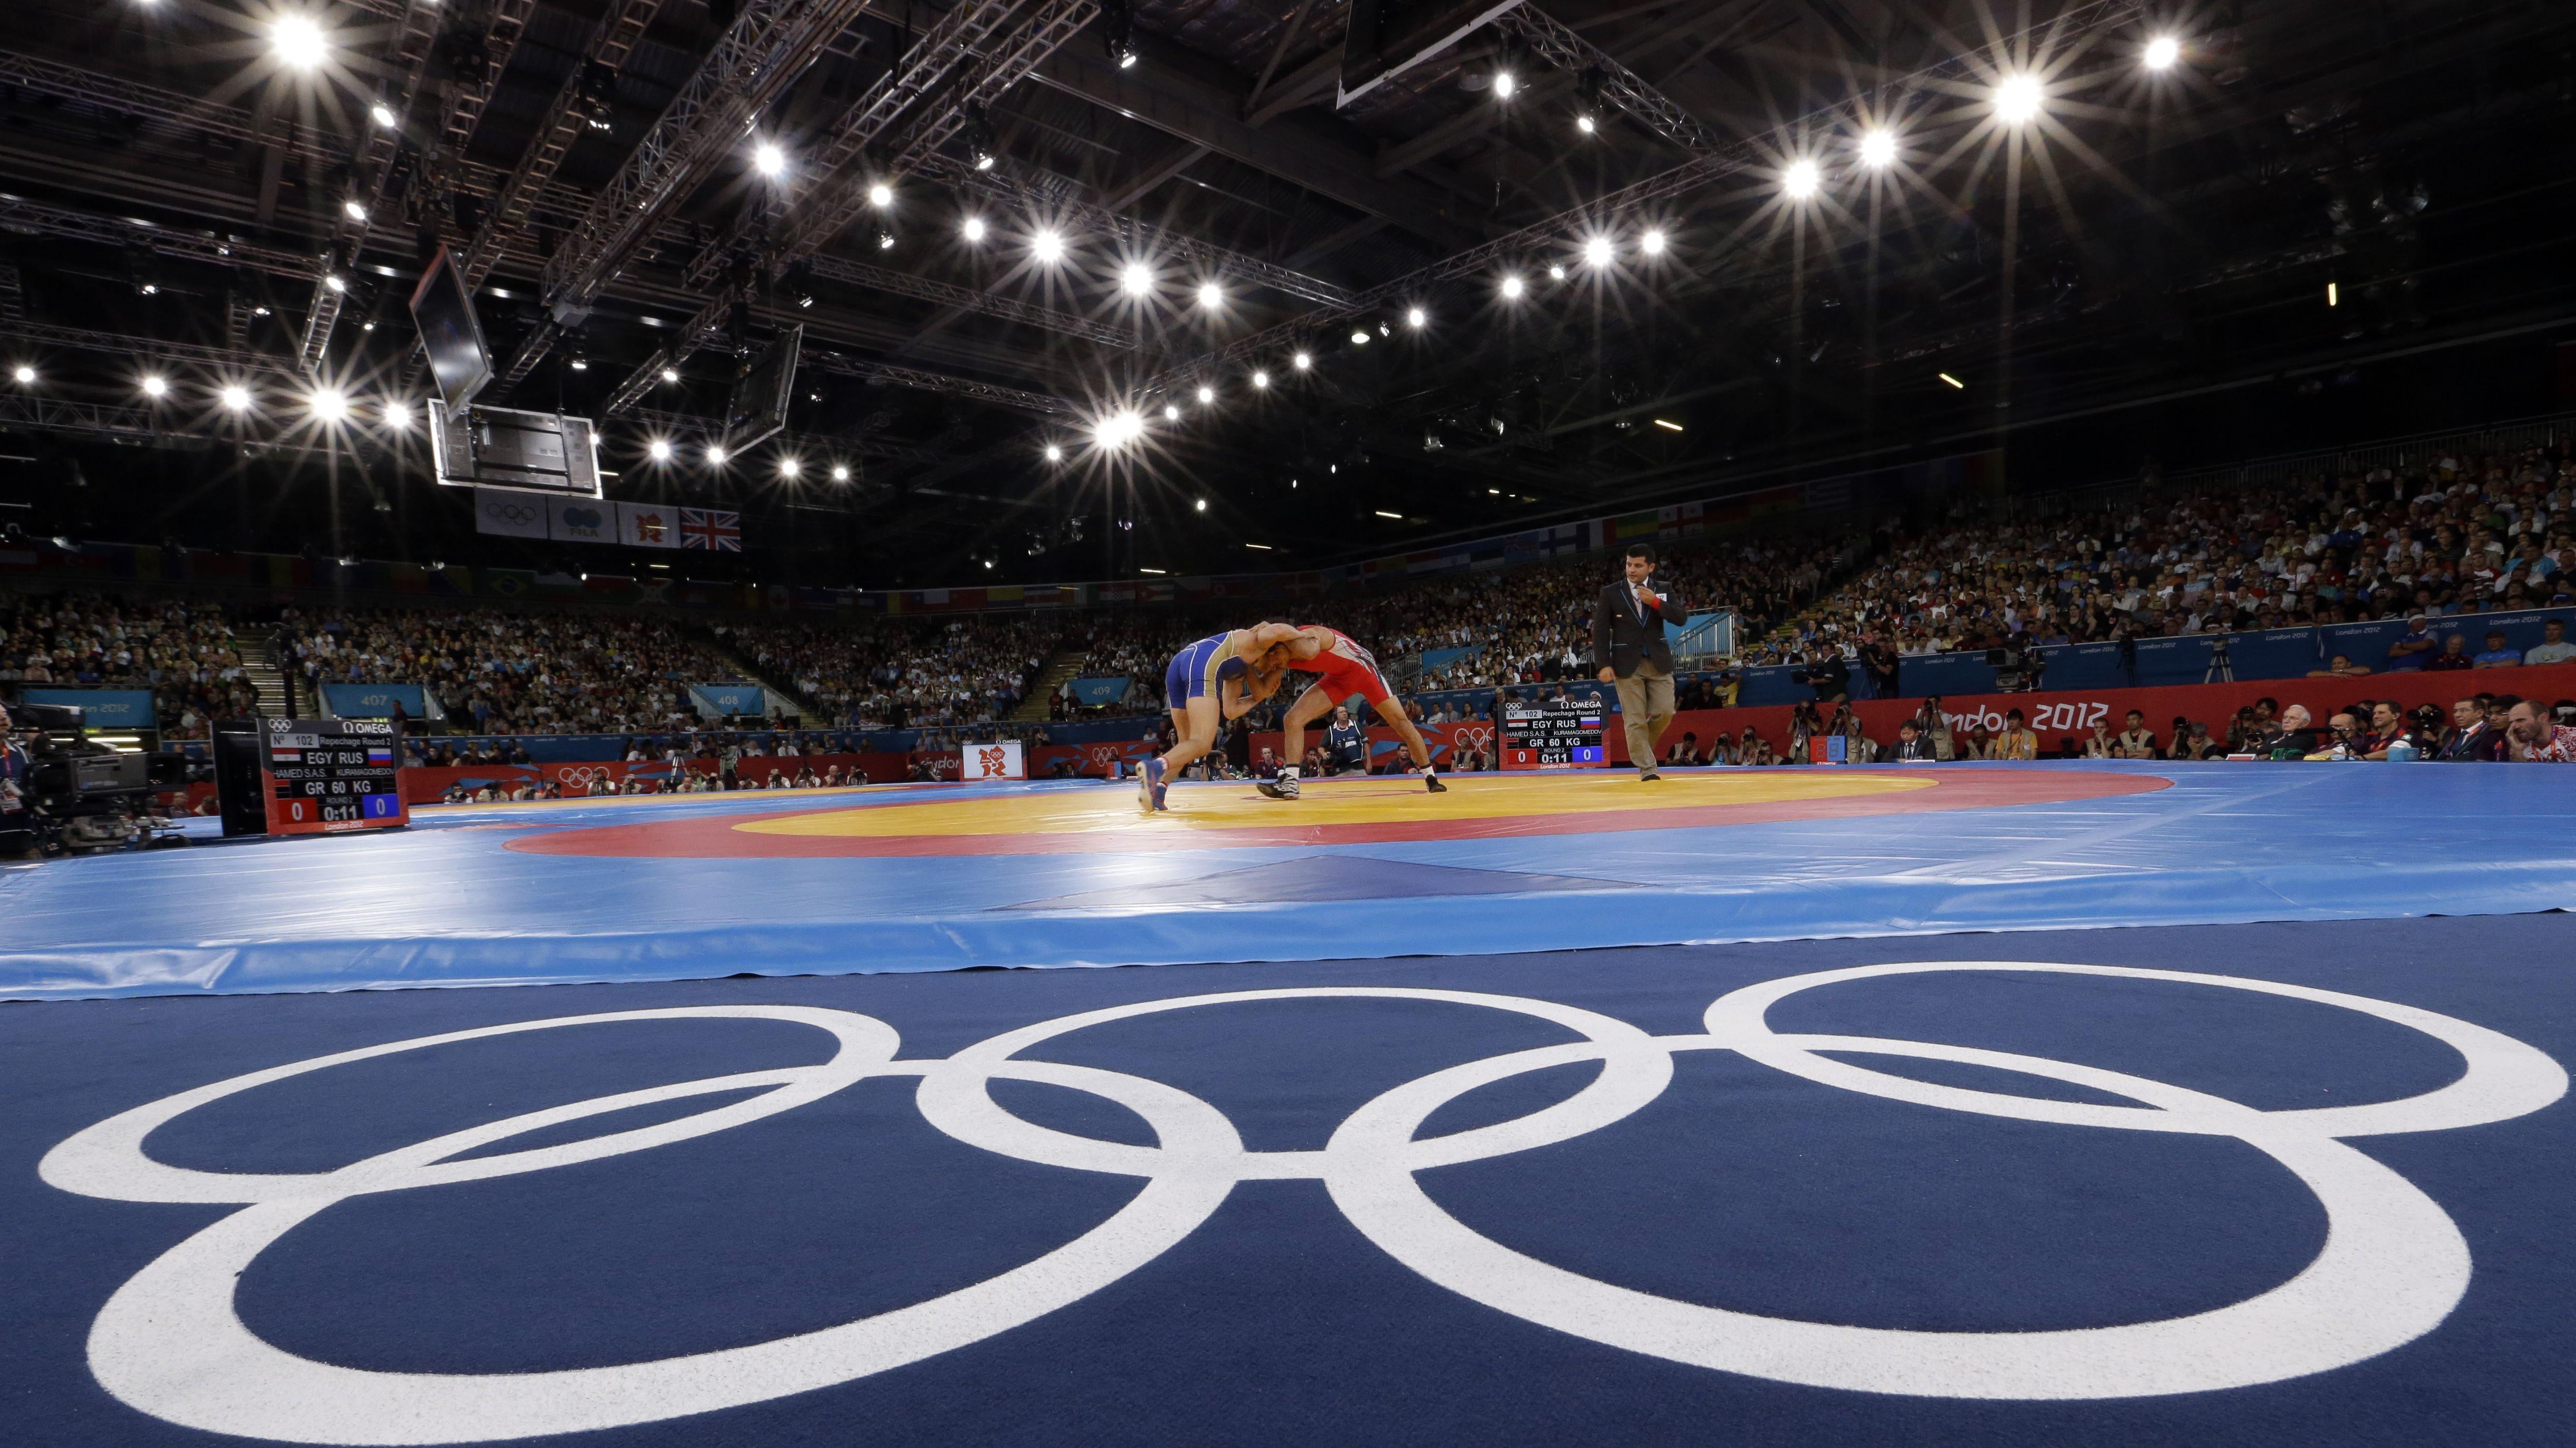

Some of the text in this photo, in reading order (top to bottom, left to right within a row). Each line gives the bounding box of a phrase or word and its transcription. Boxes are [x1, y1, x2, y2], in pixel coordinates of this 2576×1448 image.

[570, 528, 598, 537] FILA
[1092, 686, 1110, 695] 409
[361, 695, 387, 706] 407
[718, 696, 738, 705] 408
[2031, 702, 2109, 731] 2012
[356, 723, 393, 734] OMEGA
[296, 736, 313, 746] 102
[320, 738, 361, 747] Repechage
[362, 737, 385, 746] Round
[307, 752, 364, 764] EGY RUS
[1518, 751, 1526, 763] 0
[1541, 754, 1567, 763] 0:11
[1583, 750, 1591, 760] 0
[306, 781, 372, 794] GR 60 KG
[291, 802, 303, 821] 0
[375, 798, 386, 815] 0
[324, 806, 357, 821] 0:11
[325, 821, 349, 831] London
